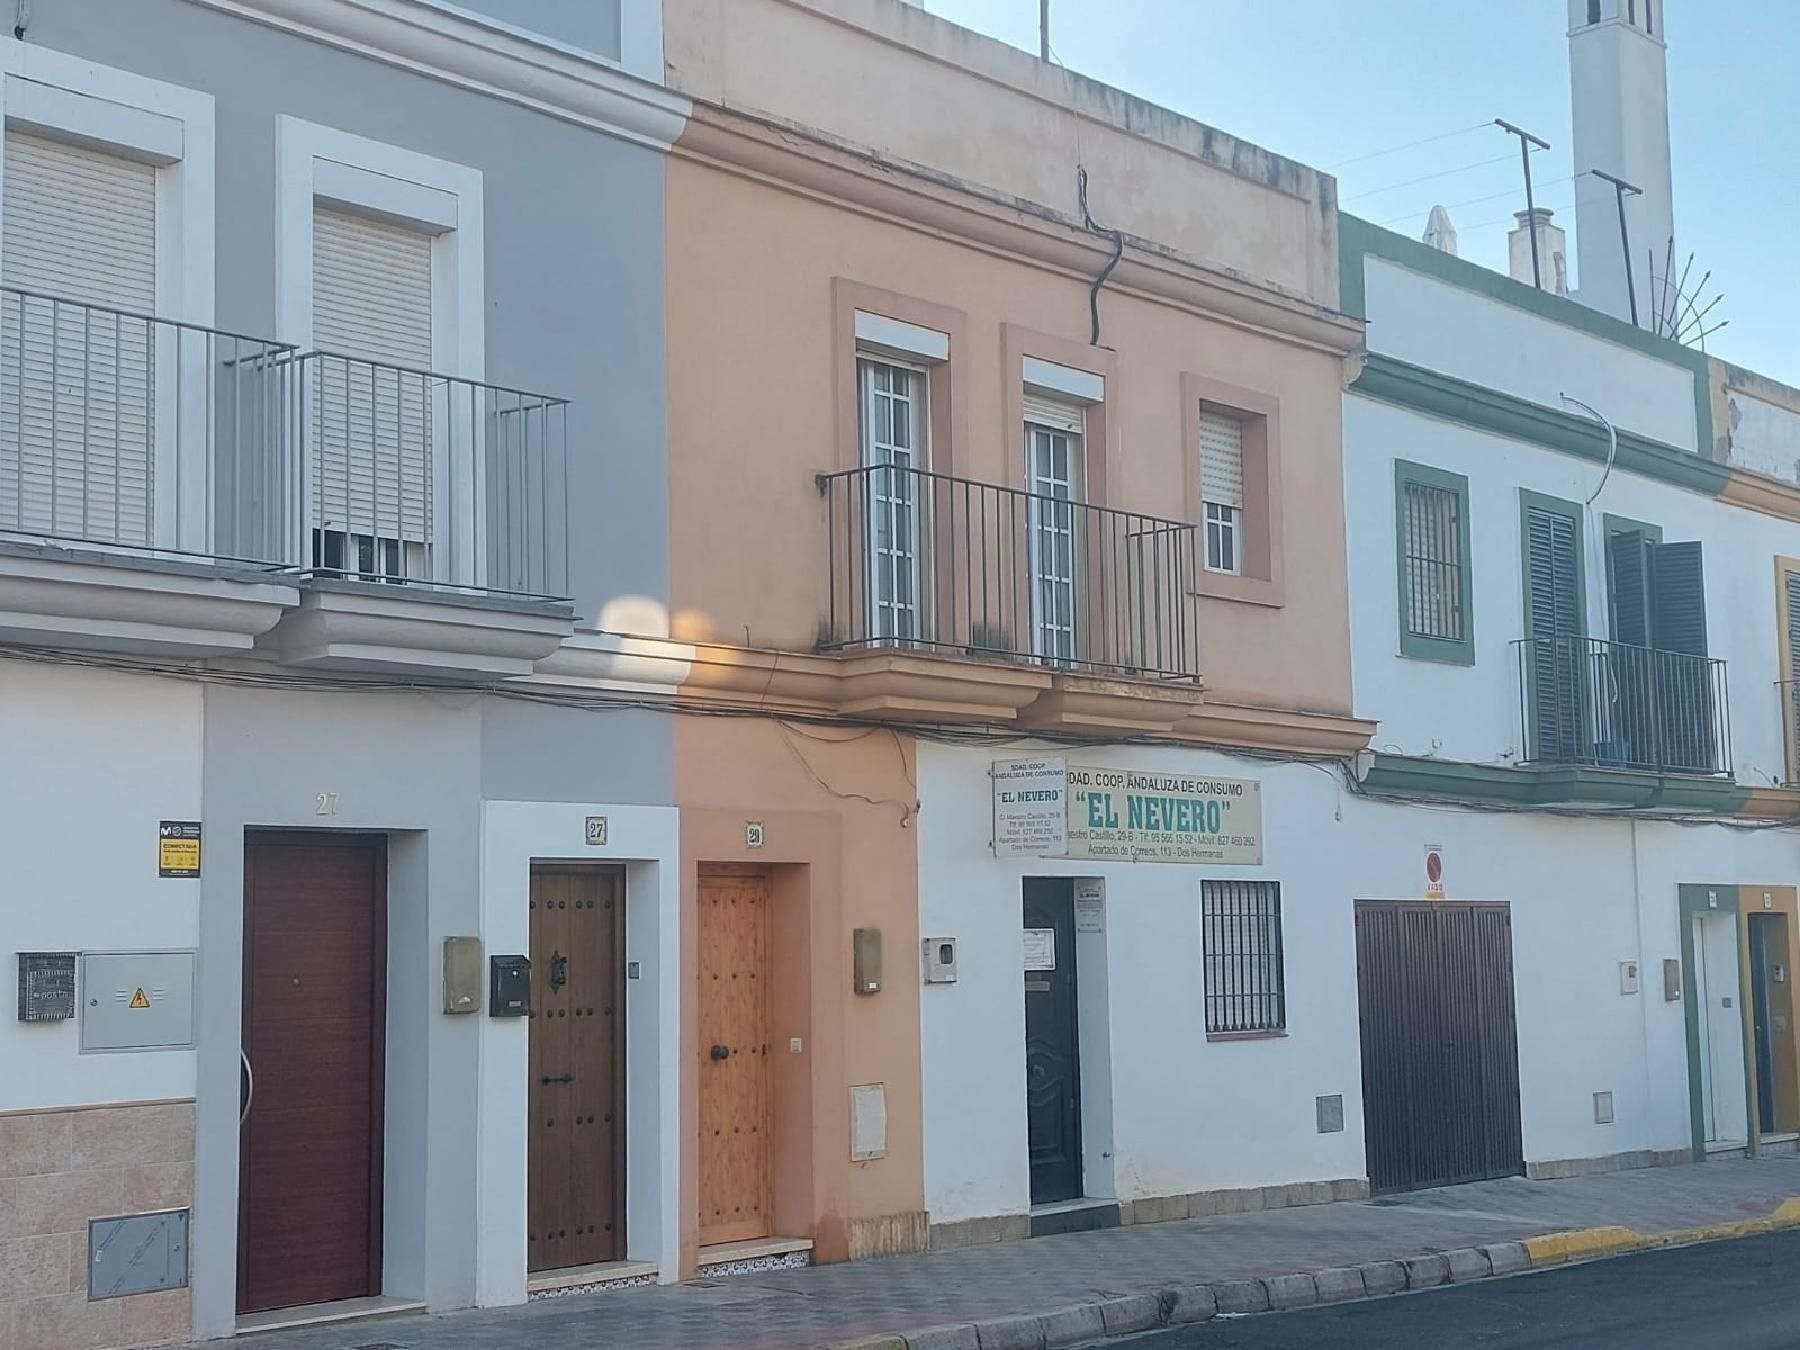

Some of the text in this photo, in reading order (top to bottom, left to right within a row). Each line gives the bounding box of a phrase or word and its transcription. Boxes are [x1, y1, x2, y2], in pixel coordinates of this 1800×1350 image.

[1067, 771, 1092, 785] DAD.
[1127, 775, 1180, 793] ANDALUZA
[1181, 780, 1195, 793] DE
[1196, 781, 1243, 796] CONSUMO
[316, 792, 339, 816] 27
[590, 823, 603, 838] 27
[1088, 843, 1118, 857] Apartado
[1121, 845, 1128, 855] de
[1177, 846, 1189, 857] Dos
